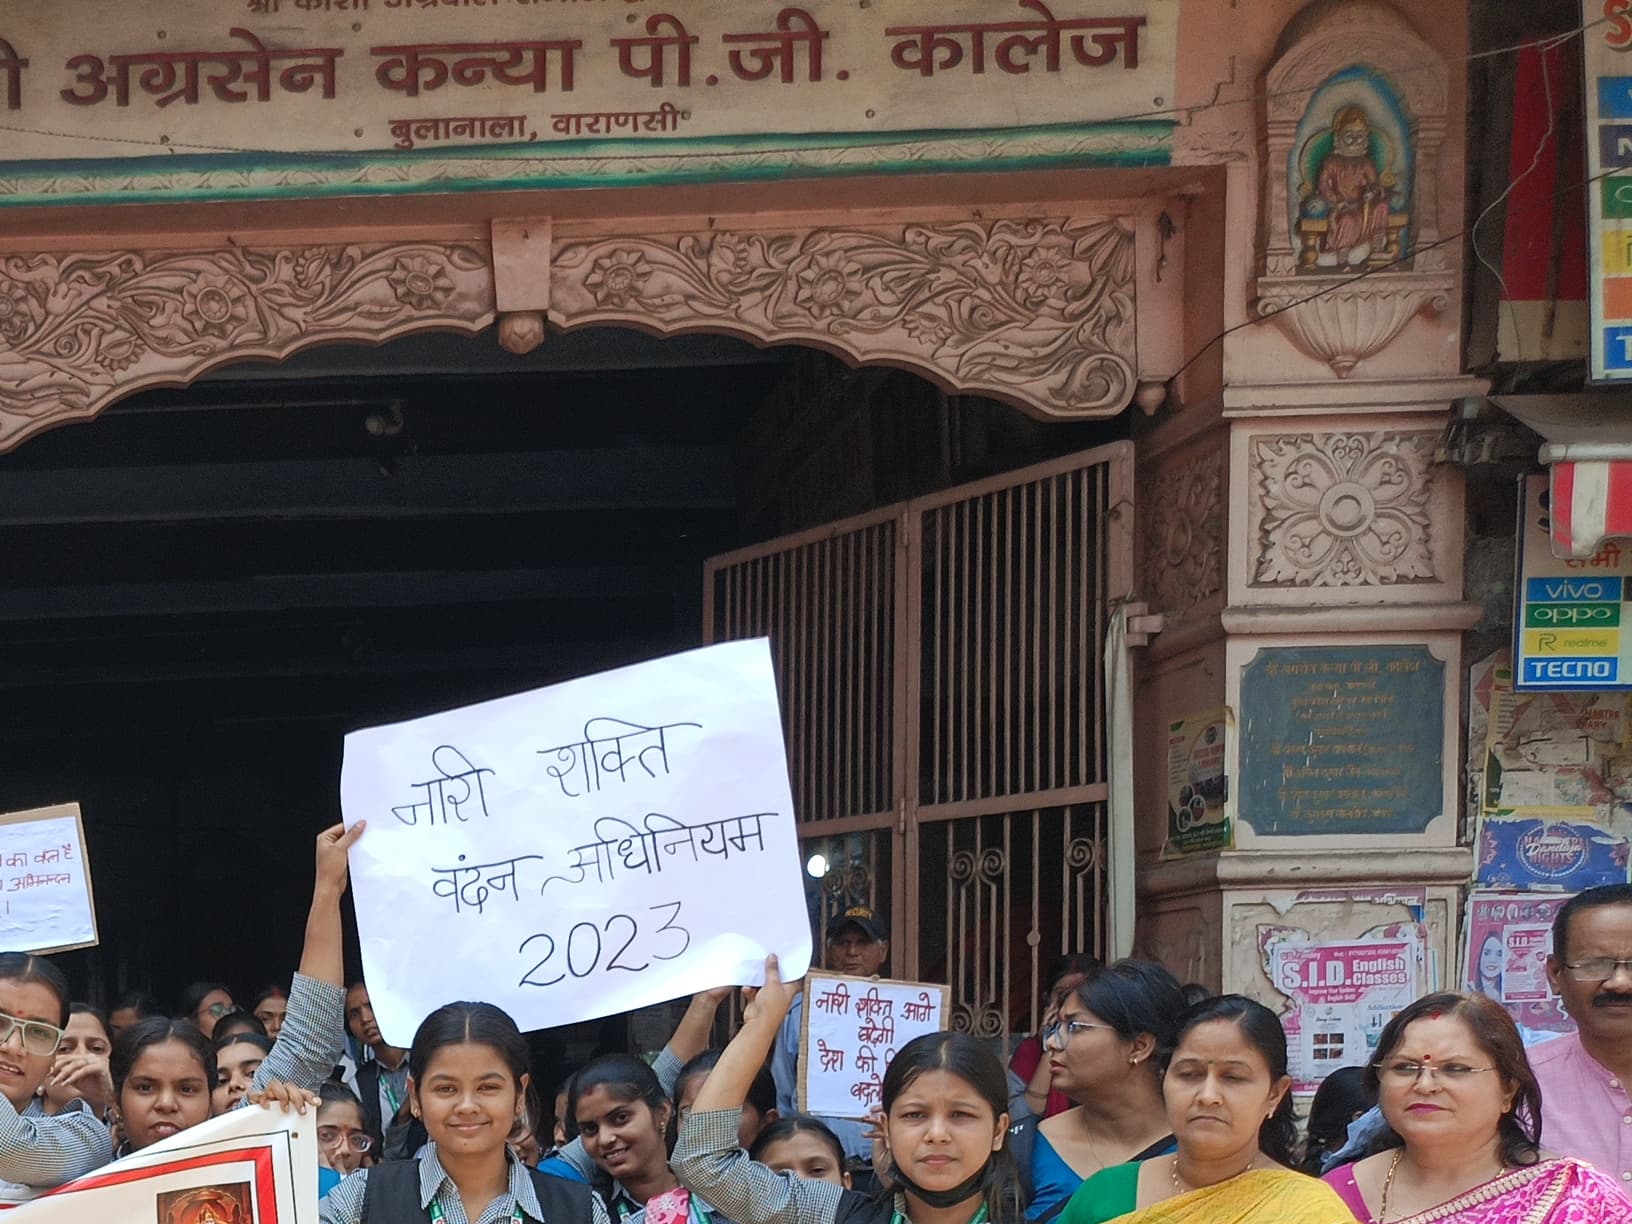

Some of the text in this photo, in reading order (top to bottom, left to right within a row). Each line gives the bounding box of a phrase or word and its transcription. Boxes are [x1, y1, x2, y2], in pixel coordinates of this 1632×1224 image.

[60, 28, 344, 107] अग्रसेन
[371, 40, 582, 96] कन्या
[610, 8, 849, 86] पी.जी.
[885, 0, 1146, 76] कालेज
[388, 102, 683, 151] बुलानाला, वाराणसी
[1530, 661, 1610, 678] TECNO
[392, 717, 702, 826] नारी शक्ति
[6, 853, 28, 867] का
[431, 812, 779, 913] वंदन अधिनियम
[518, 901, 690, 987] 2023
[1282, 956, 1406, 989] S.I.D. English
[1352, 972, 1406, 985] Classes
[816, 983, 936, 1022] नारी शक्ति आगे
[817, 1039, 844, 1072] देश
[855, 1045, 878, 1073] की
